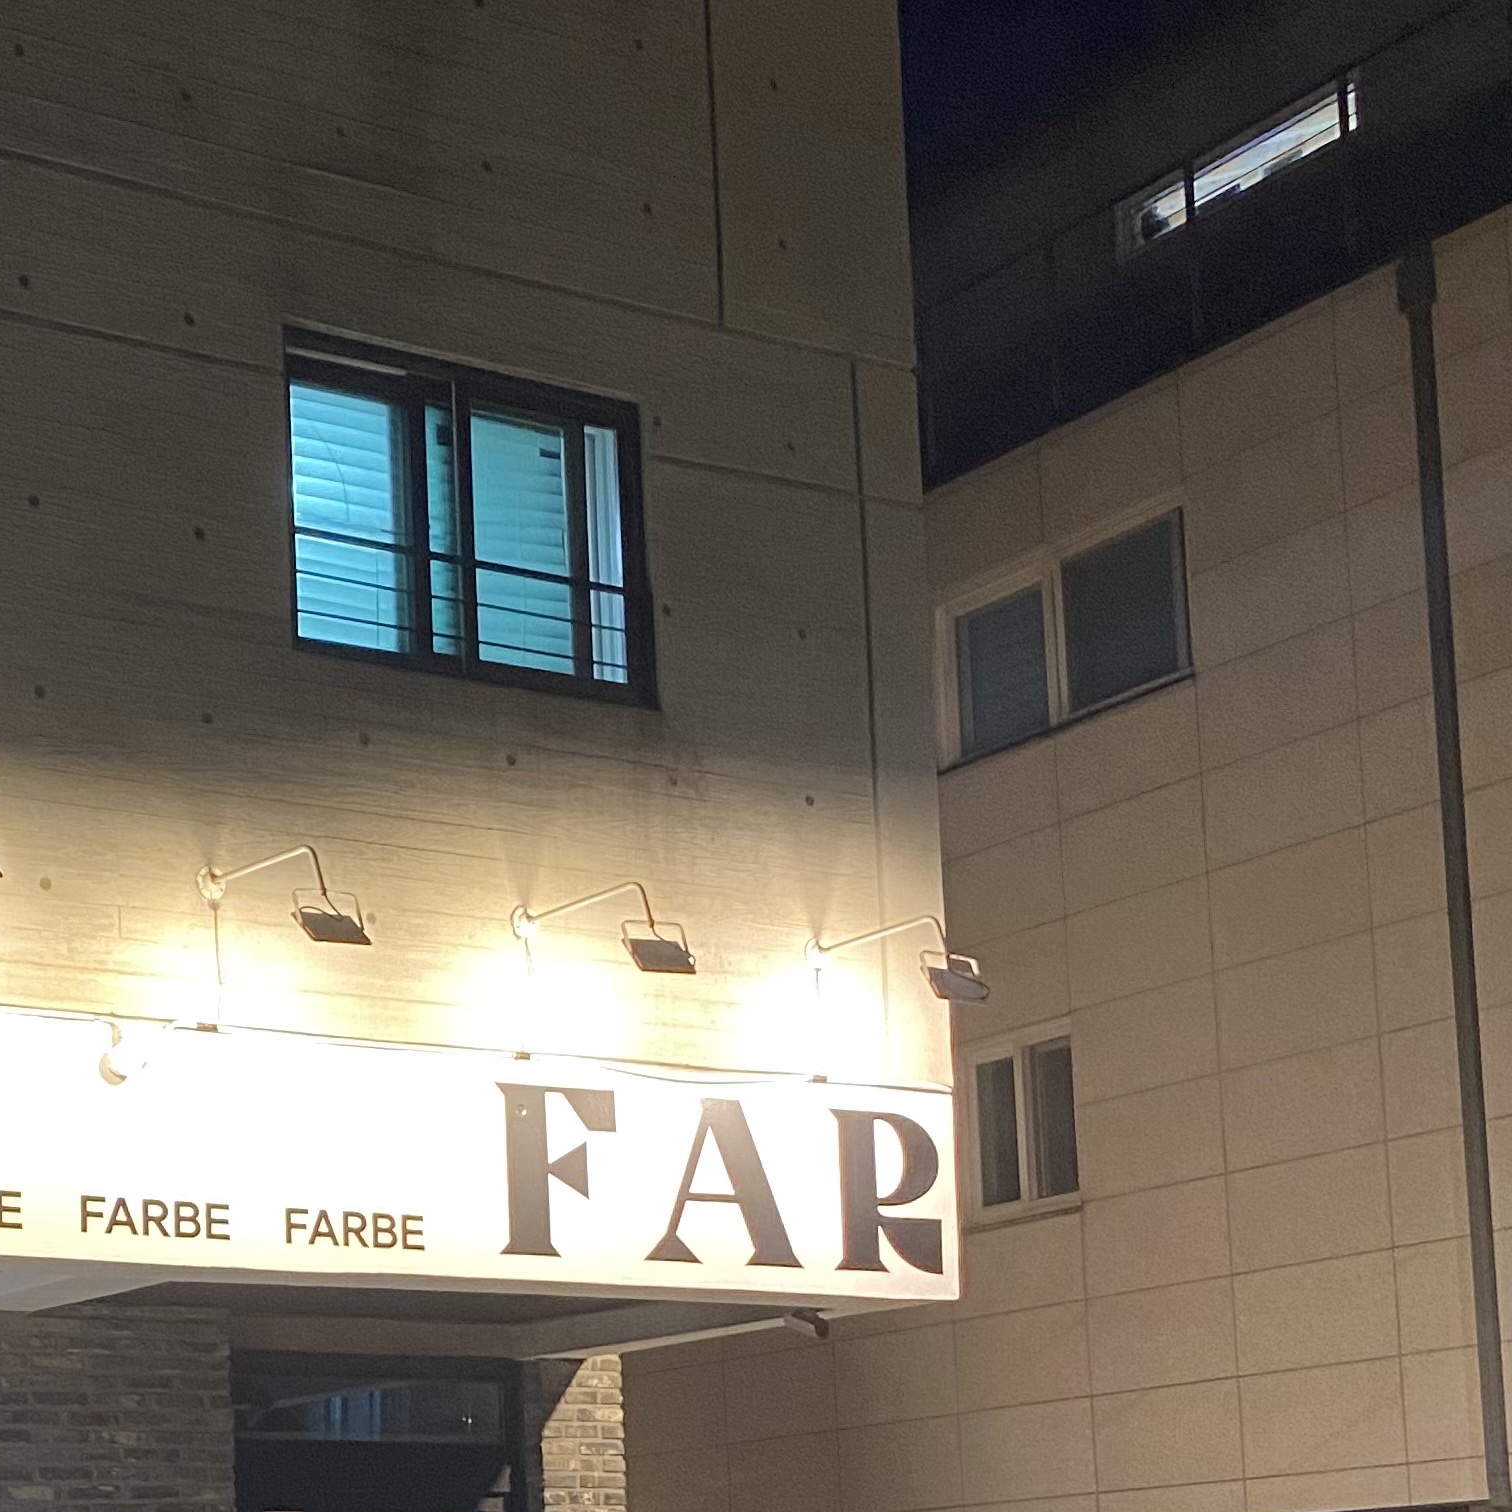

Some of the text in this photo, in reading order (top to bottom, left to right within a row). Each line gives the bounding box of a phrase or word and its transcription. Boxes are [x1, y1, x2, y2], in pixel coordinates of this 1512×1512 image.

[80, 1193, 232, 1241] FARBE
[284, 1206, 426, 1251] FARBE
[494, 1081, 944, 1275] FAR
